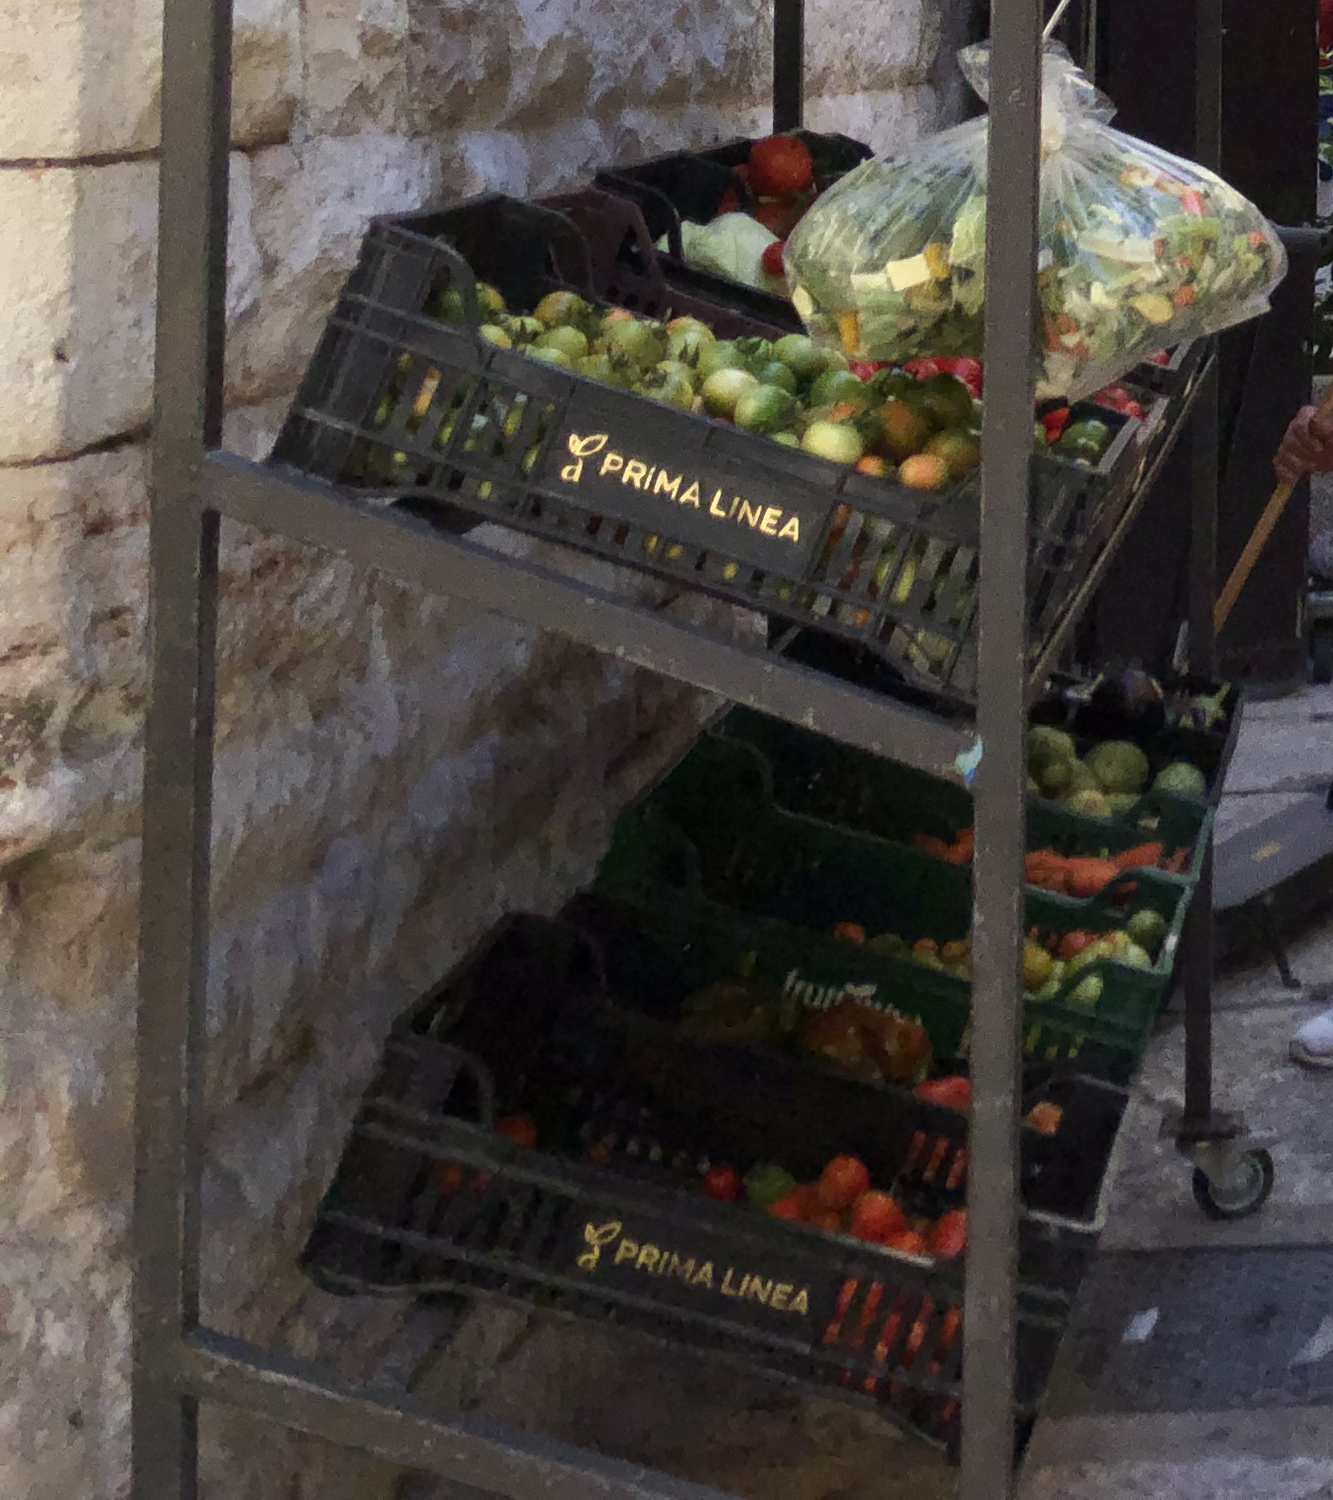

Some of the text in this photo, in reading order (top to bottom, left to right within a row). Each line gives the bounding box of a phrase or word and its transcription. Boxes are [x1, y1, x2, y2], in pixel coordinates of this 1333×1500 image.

[600, 453, 801, 543] PRIMA LINEA
[614, 1238, 810, 1316] PRIMA LINEA
